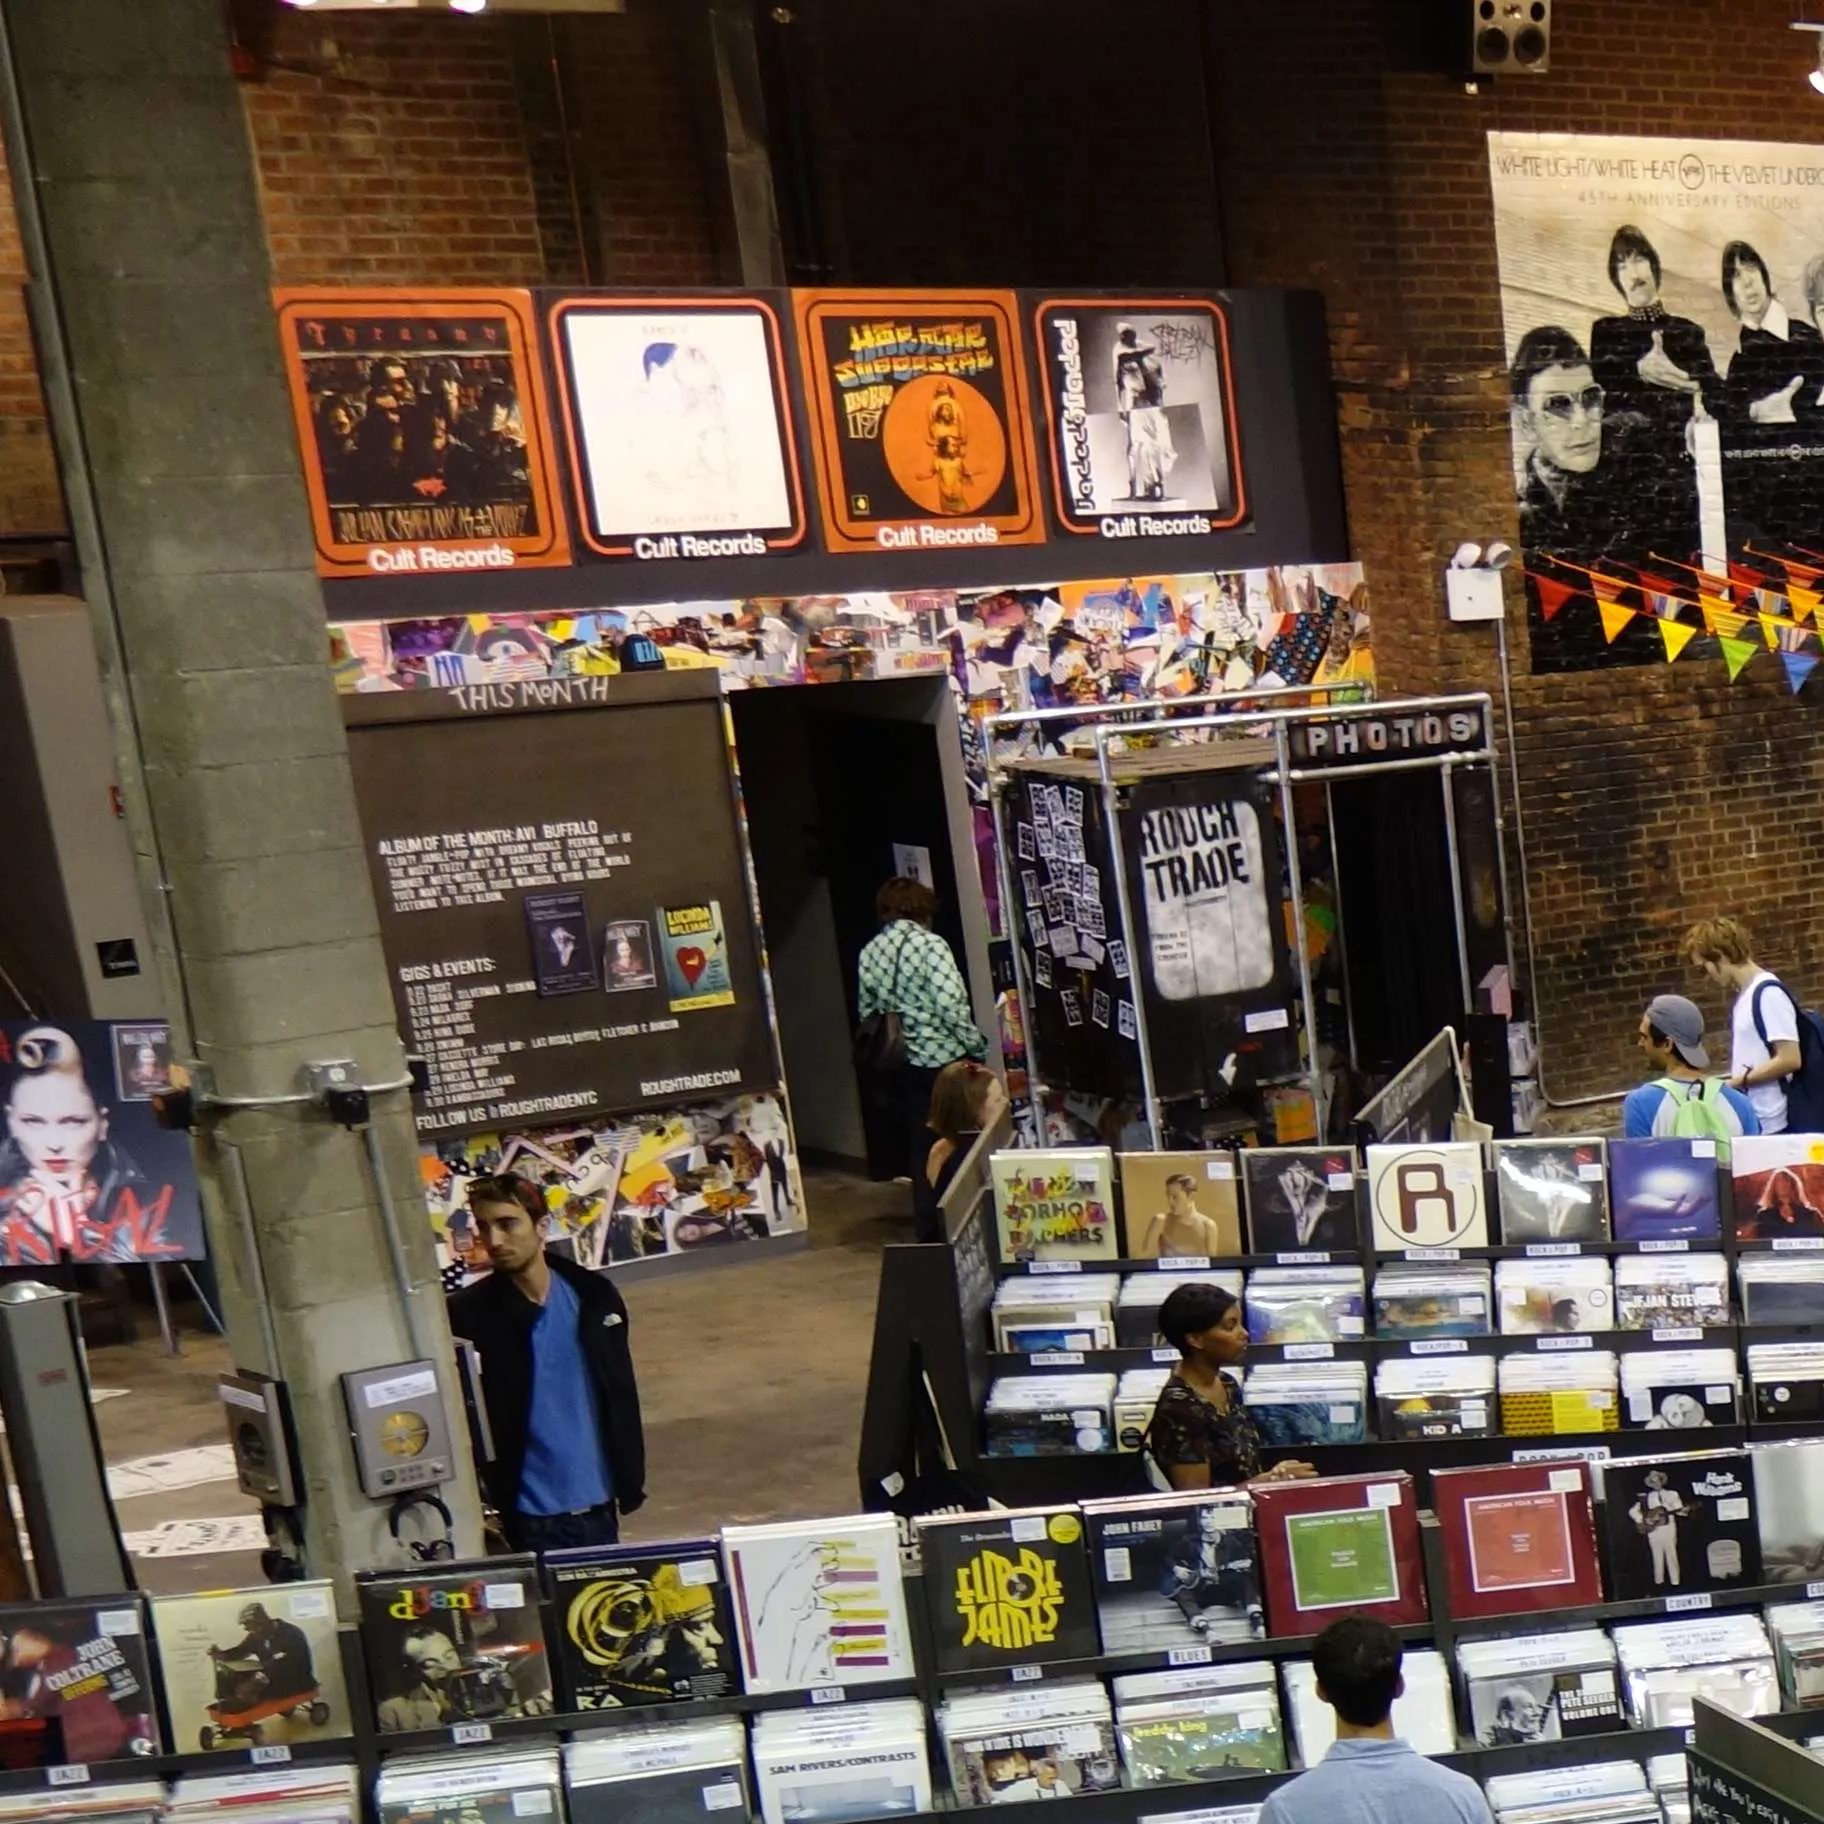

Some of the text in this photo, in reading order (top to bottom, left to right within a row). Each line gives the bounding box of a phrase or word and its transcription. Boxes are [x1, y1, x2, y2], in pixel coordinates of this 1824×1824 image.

[1643, 160, 1677, 177] HEAT
[879, 523, 998, 548] Cult Records
[1101, 514, 1211, 538] Cult Records
[369, 544, 515, 573] Cult Records
[636, 532, 766, 559] Cult Records
[448, 684, 517, 711] THIS
[1306, 712, 1474, 757] PHOTOS
[379, 838, 422, 855] ALBUM
[442, 834, 467, 848] THE
[542, 820, 598, 839] BUFFALO
[1139, 801, 1240, 858] ROUGH
[1145, 843, 1251, 902] TRADE
[400, 967, 430, 982] GIGS
[415, 1109, 466, 1130] FOLLOW
[469, 1106, 487, 1121] US
[1423, 1424, 1462, 1436] KID A
[1103, 1520, 1162, 1536] JOHN FAHEY
[955, 1548, 1064, 1606] ELMORE
[1669, 1596, 1711, 1609] COUNTRY
[956, 1597, 1065, 1648] JAMES
[77, 1635, 117, 1662] JOHN
[1173, 1648, 1209, 1663] BLUES
[44, 1654, 125, 1692] COLTRANE
[770, 1751, 917, 1775] SAM RIVERS/CONTRASTS
